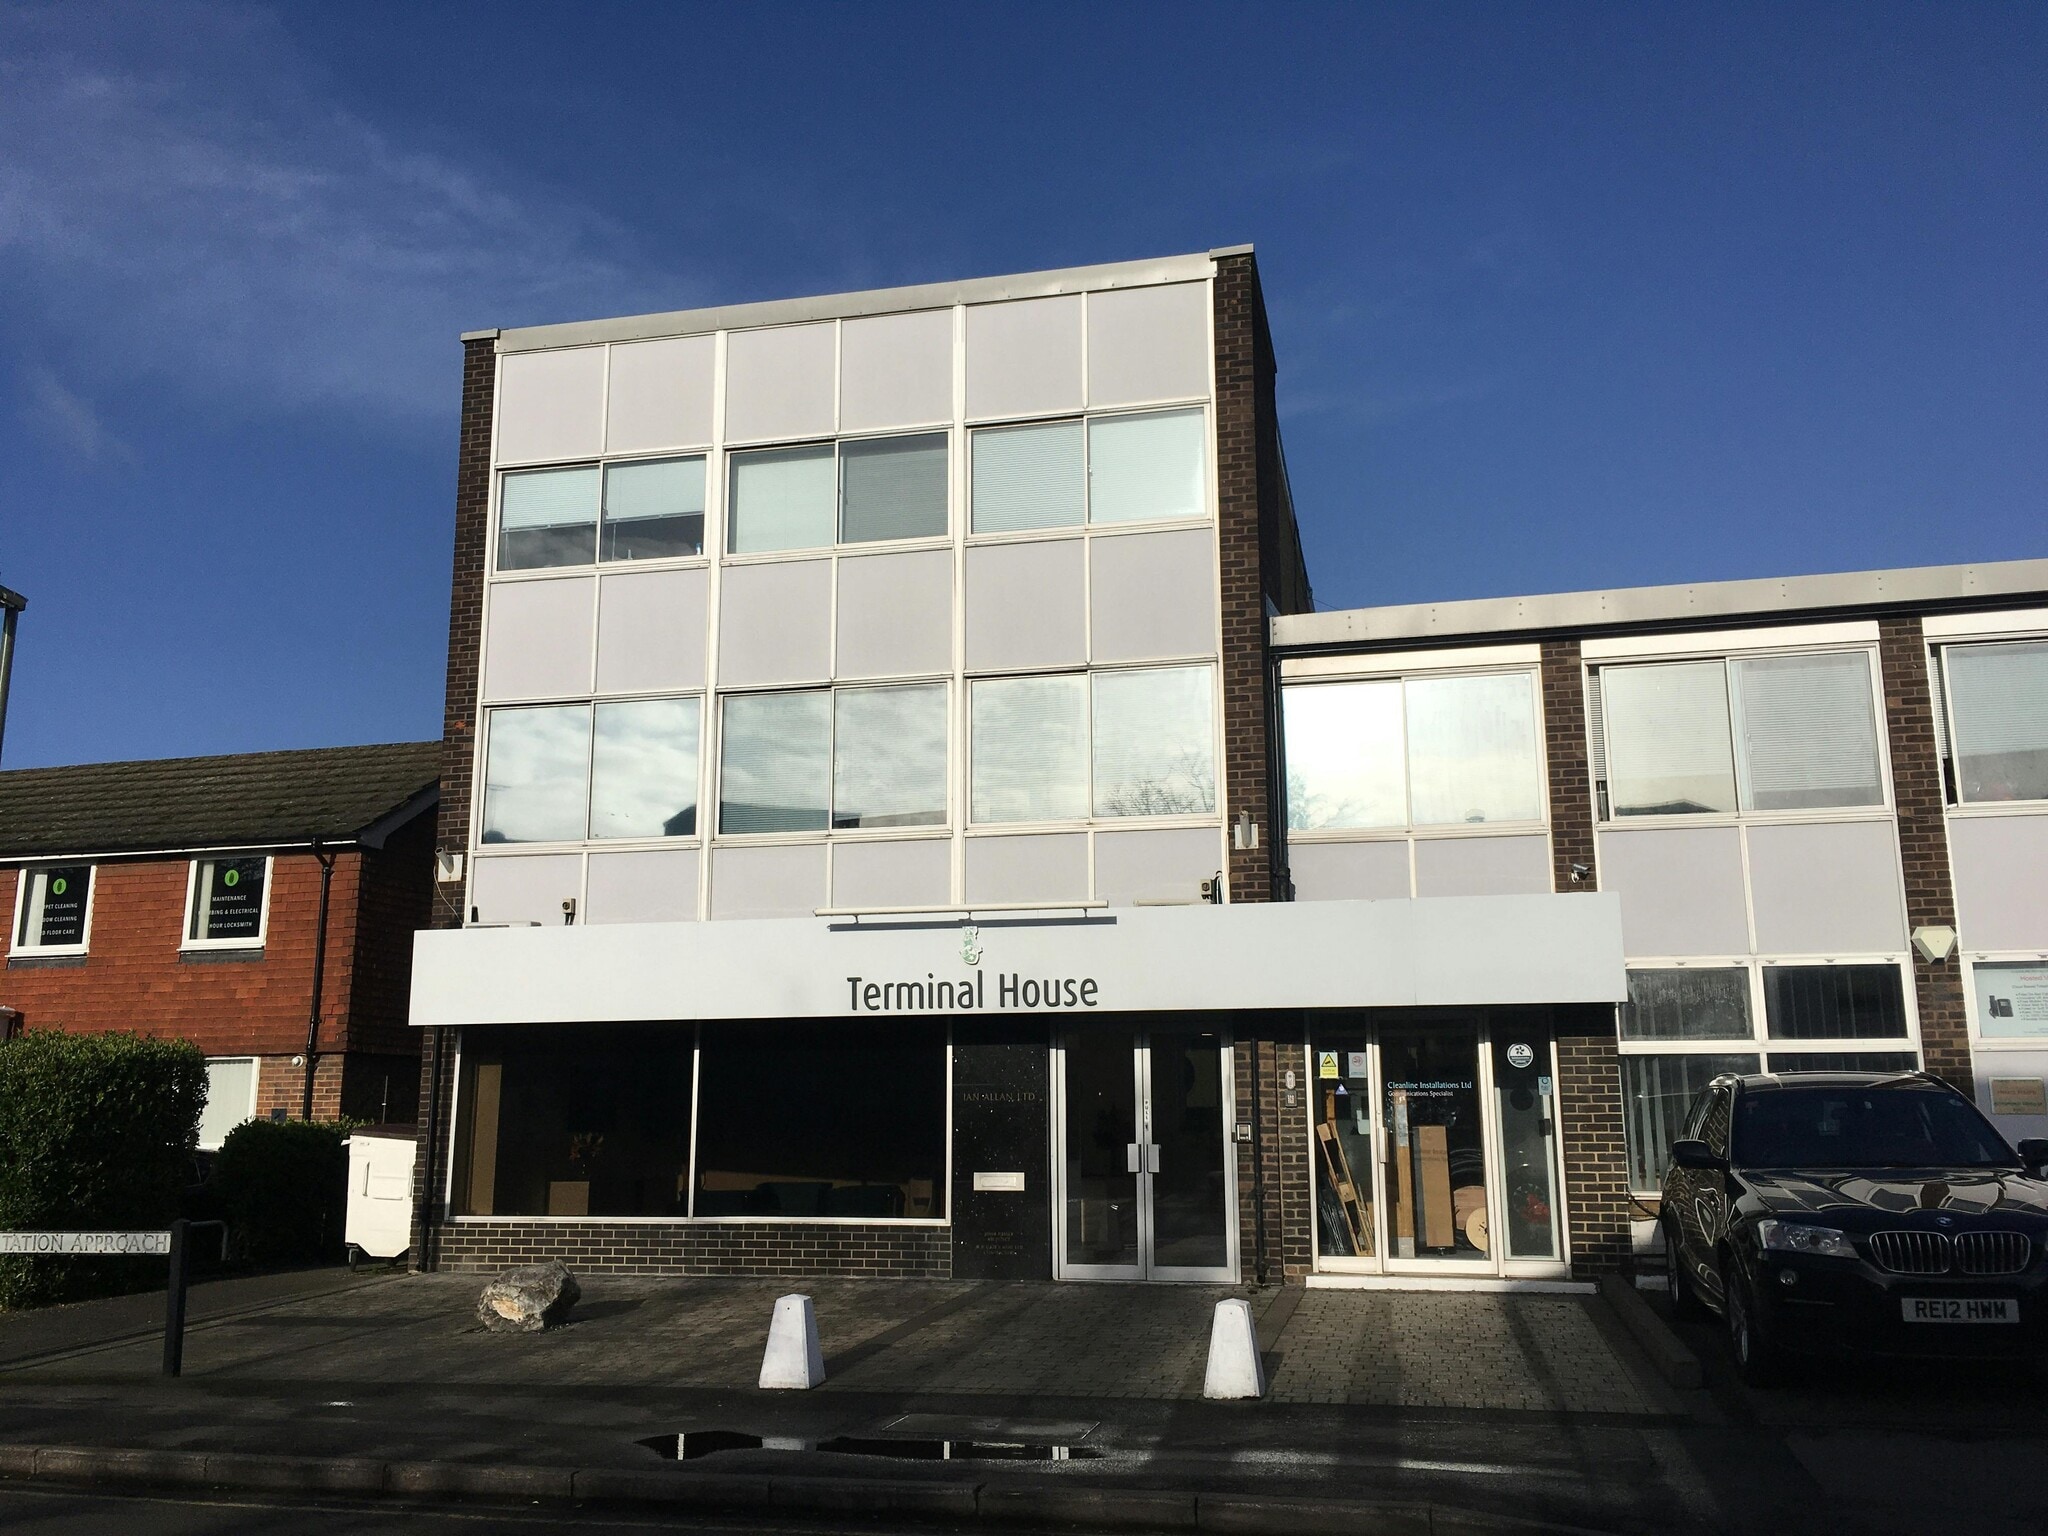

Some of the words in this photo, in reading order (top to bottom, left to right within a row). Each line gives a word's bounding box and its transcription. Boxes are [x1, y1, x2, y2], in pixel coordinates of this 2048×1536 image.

[212, 894, 247, 902] MAINTENANCE
[54, 902, 78, 910] CLEANING
[224, 921, 253, 929] LOCKSMITH
[847, 970, 983, 1010] Terminal
[999, 973, 1098, 1008] House
[1387, 1081, 1418, 1089] Cleanline
[1419, 1081, 1459, 1089] Installations
[1460, 1081, 1472, 1089] Ltd
[963, 1092, 979, 1101] IAN
[983, 1092, 1013, 1101] ALLAN
[1017, 1092, 1035, 1101] LTD
[2, 1234, 63, 1251] TATION
[71, 1234, 167, 1251] APPROACH
[1915, 1300, 1961, 1319] RE12
